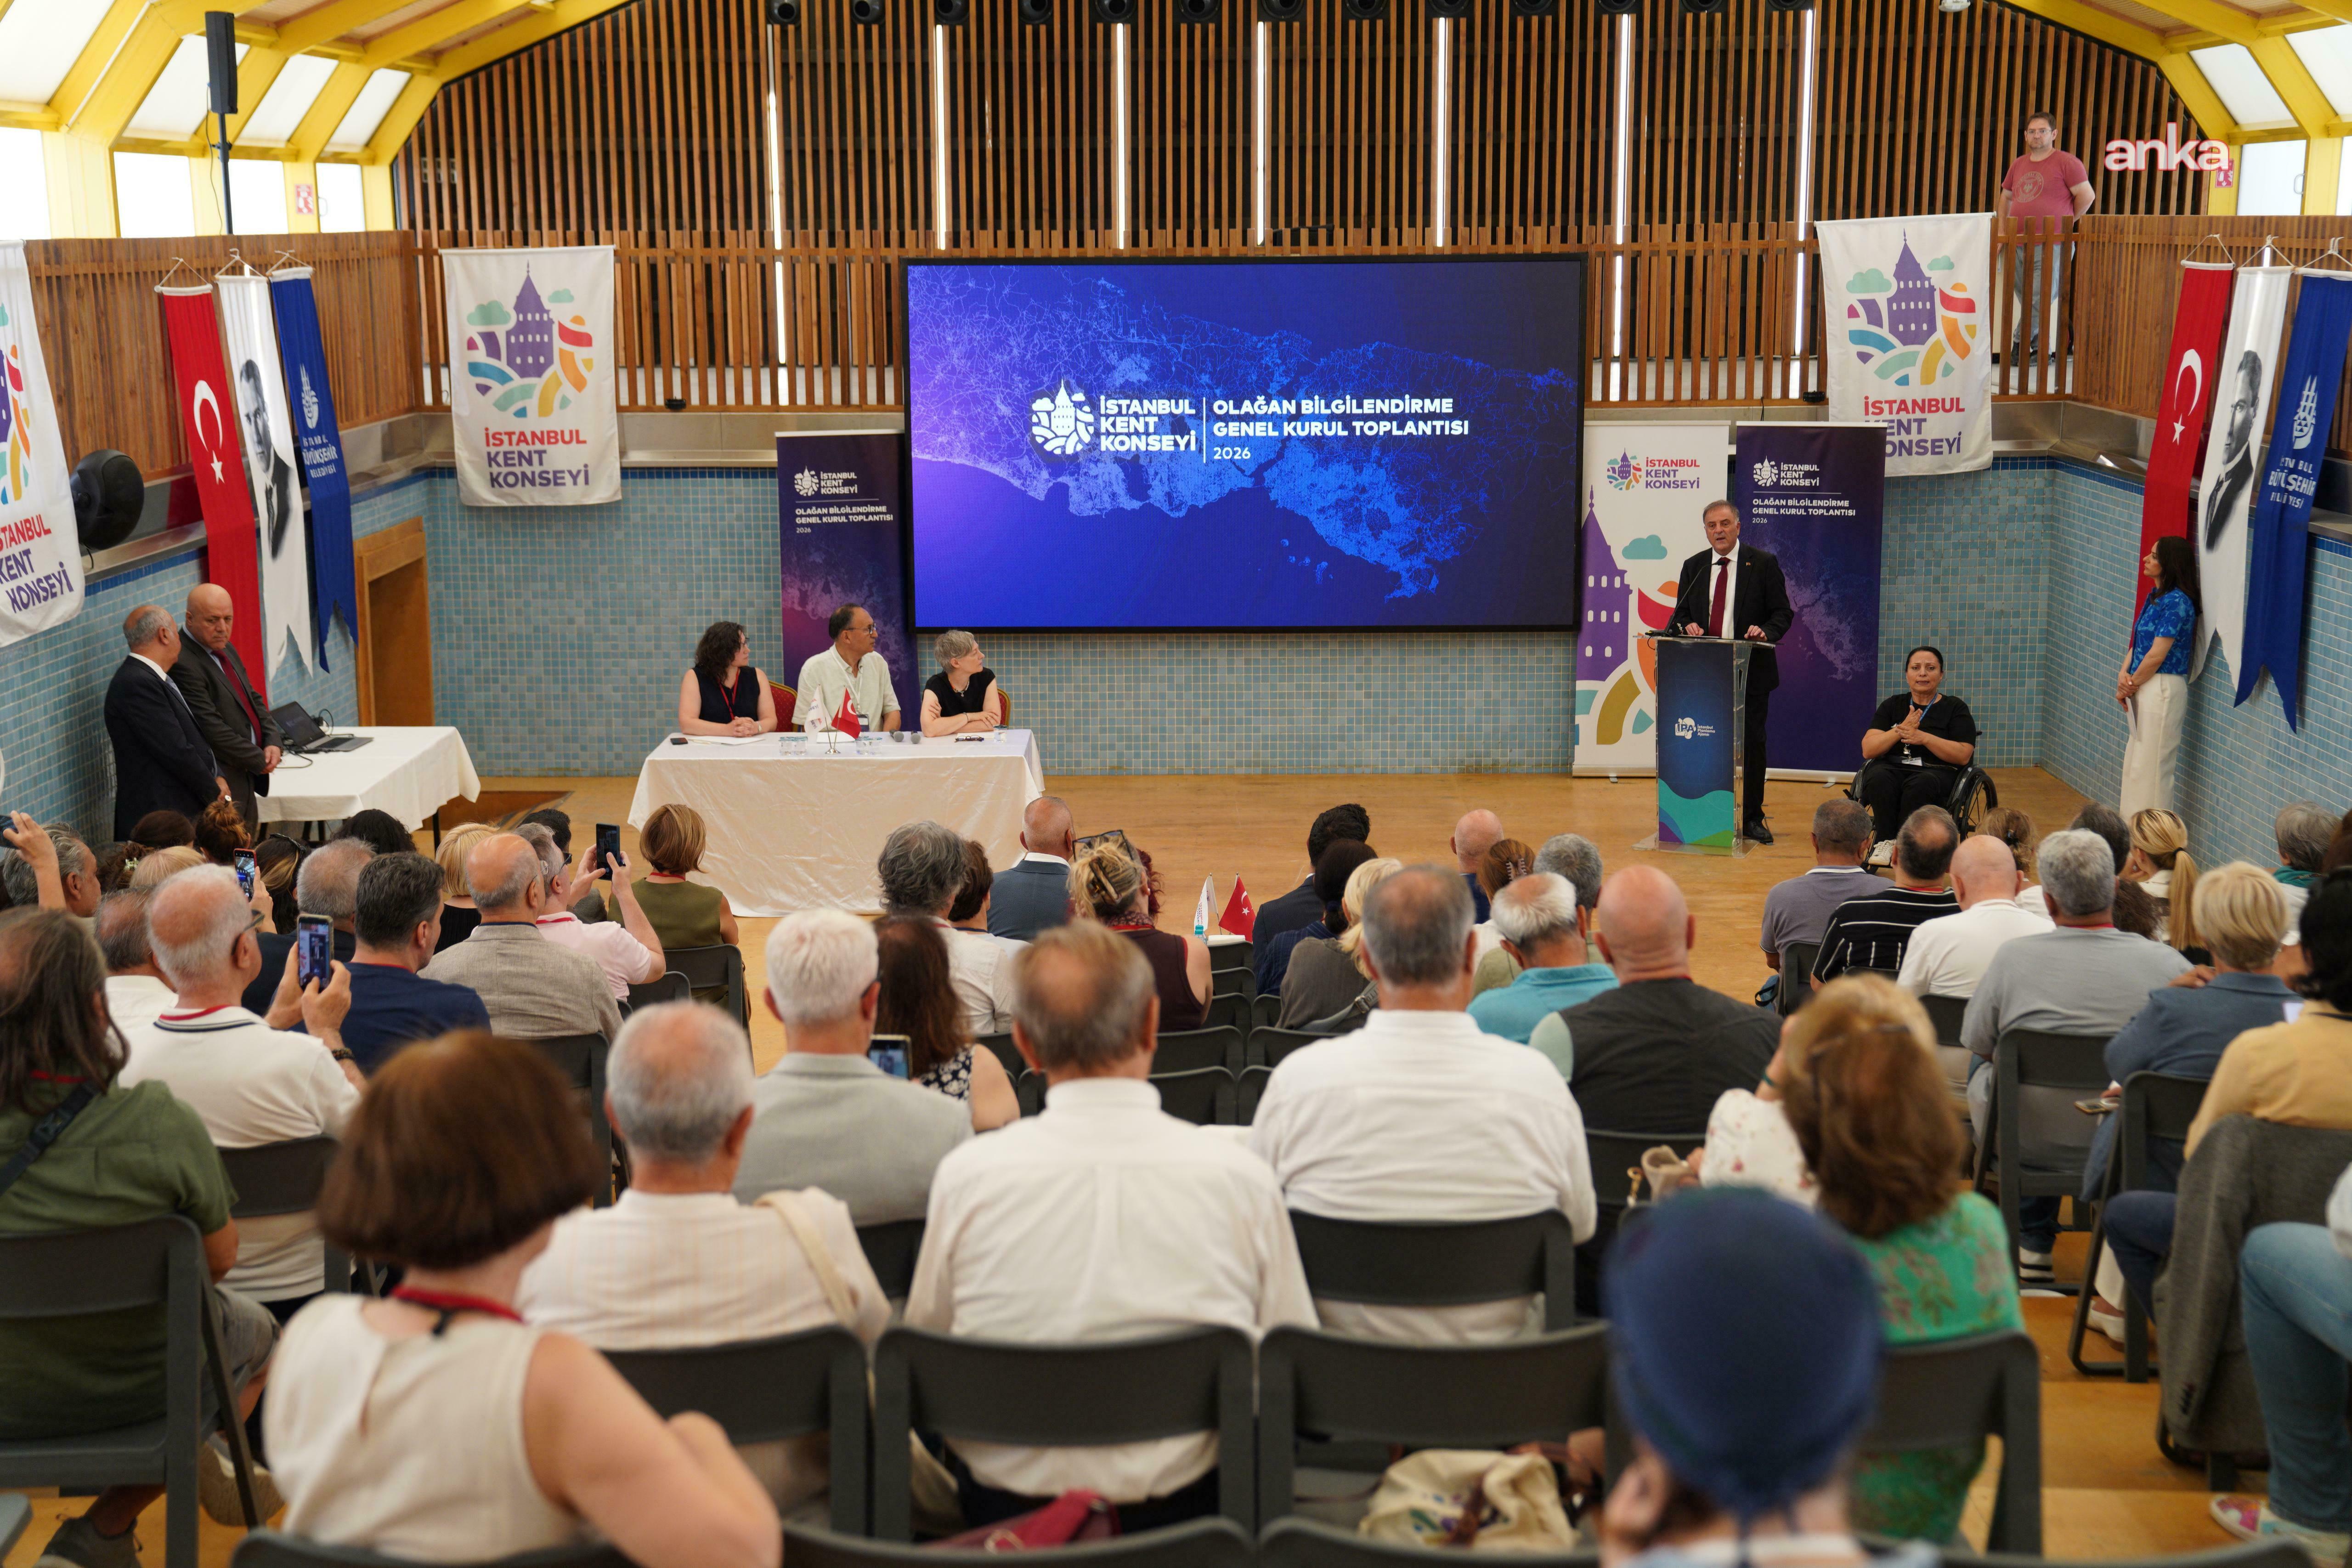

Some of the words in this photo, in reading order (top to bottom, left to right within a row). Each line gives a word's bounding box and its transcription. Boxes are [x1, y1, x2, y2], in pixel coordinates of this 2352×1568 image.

[1100, 395, 1196, 414] İSTANBUL
[1213, 396, 1296, 414] OLAĞAN
[1301, 394, 1453, 414] BİLGİLENDİRME
[1864, 396, 1965, 416] İSTANBUL
[1100, 416, 1158, 433] KENT
[1213, 422, 1279, 436] GENEL
[1283, 421, 1348, 436] KURUL
[1352, 420, 1469, 436] TOPLANTISI
[1865, 418, 1927, 436] ENT
[485, 427, 587, 447] İSTANBUL
[1100, 430, 1196, 451] KONSEYİ
[1885, 431, 1962, 458] ONSEYİ
[487, 450, 547, 468] KENT
[1213, 447, 1251, 459] 2026
[1646, 457, 1700, 467] İSTANBUL
[1781, 462, 1820, 471] İSTANBUL
[490, 464, 589, 488] KONSEYİ
[820, 471, 857, 480] İSTANBUL
[1645, 469, 1679, 478] KENT
[1780, 477, 1820, 486] KONSEYİ
[820, 484, 858, 494] KONSEYİ
[1645, 477, 1700, 489] KONSEYİ
[2268, 469, 2316, 496] BÜYÜŞEHİR
[795, 506, 828, 515] OLAĞAN
[829, 504, 887, 514] BİLGİLENDİRME
[1788, 498, 1849, 507] BİLGİLENDİRME
[6, 561, 74, 613] KONSEYİ
